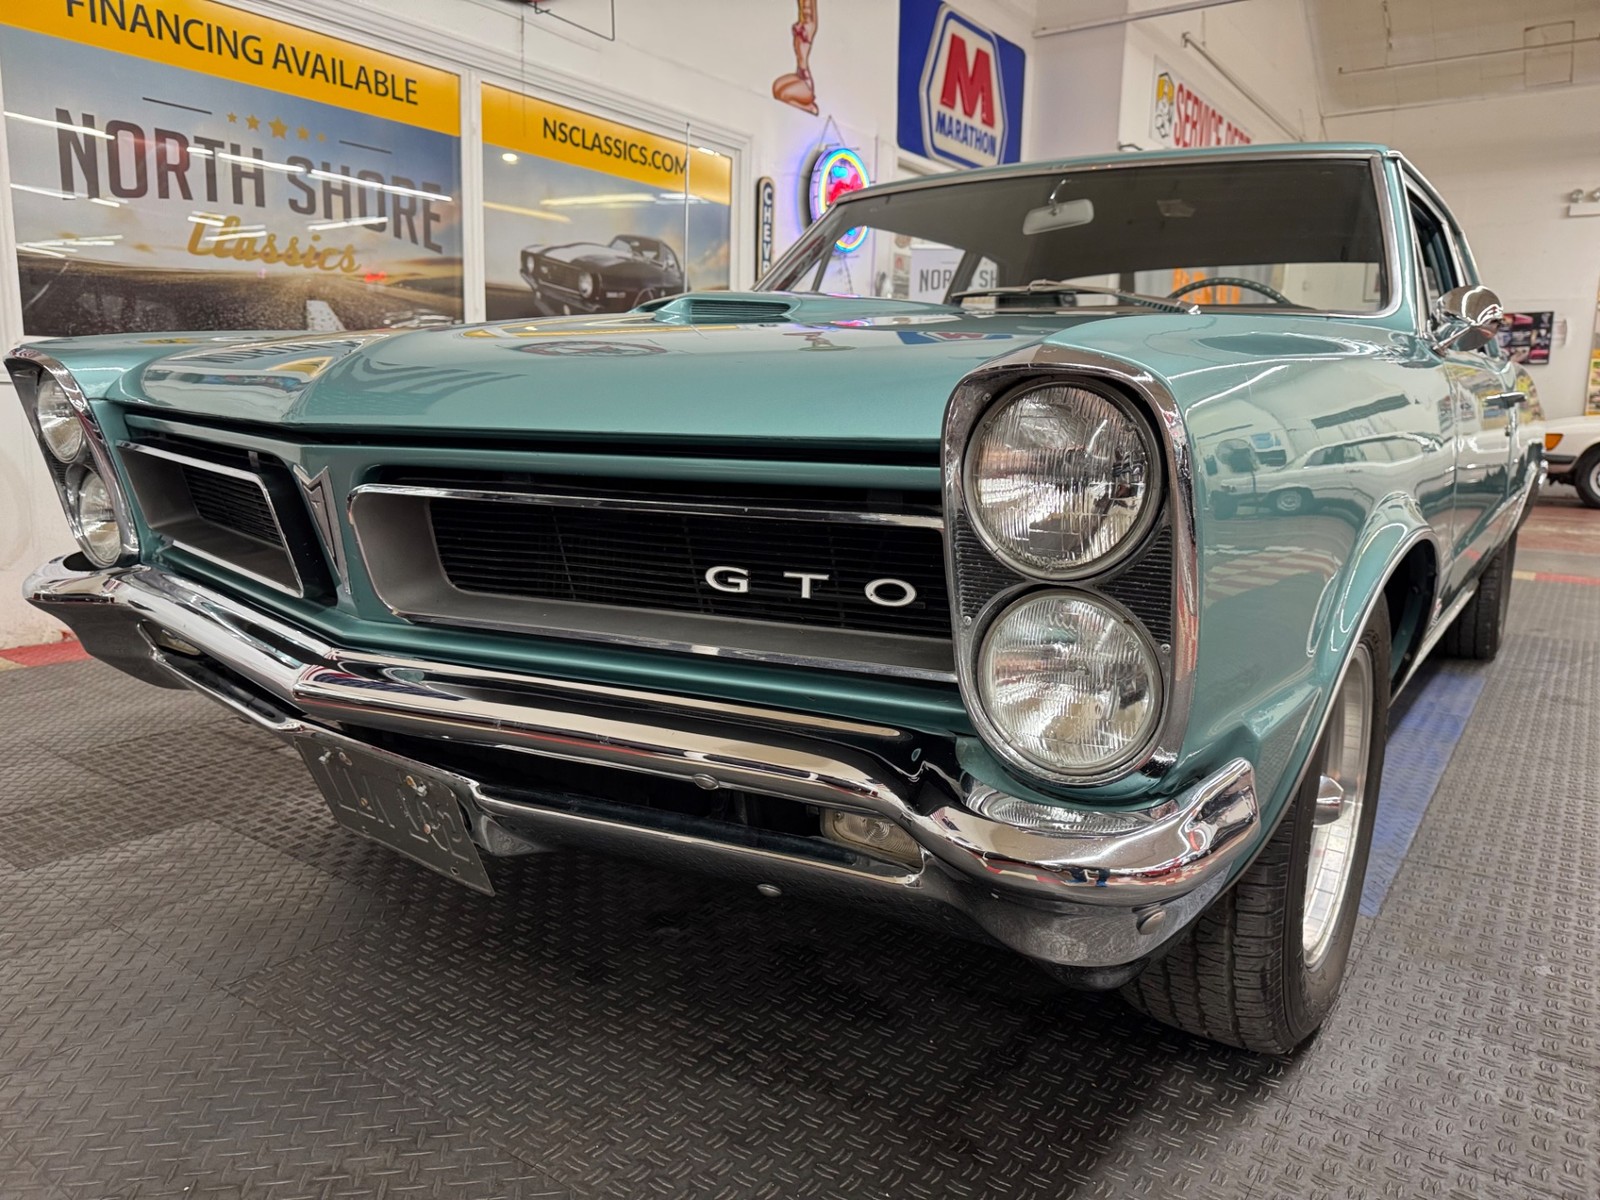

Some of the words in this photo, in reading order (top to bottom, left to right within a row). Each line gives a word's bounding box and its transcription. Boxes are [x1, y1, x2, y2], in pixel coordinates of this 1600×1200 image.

[66, 0, 264, 66] FINANCING
[272, 42, 419, 106] AVAILABLE
[940, 33, 995, 129] M
[542, 117, 688, 176] NSCLASSICS.COM
[936, 110, 997, 158] MARATHON
[1174, 82, 1224, 148] SERVICE
[56, 107, 267, 208] NORTH
[286, 155, 444, 255] SHORE
[186, 211, 362, 274] Classics
[705, 565, 918, 608] GTO
